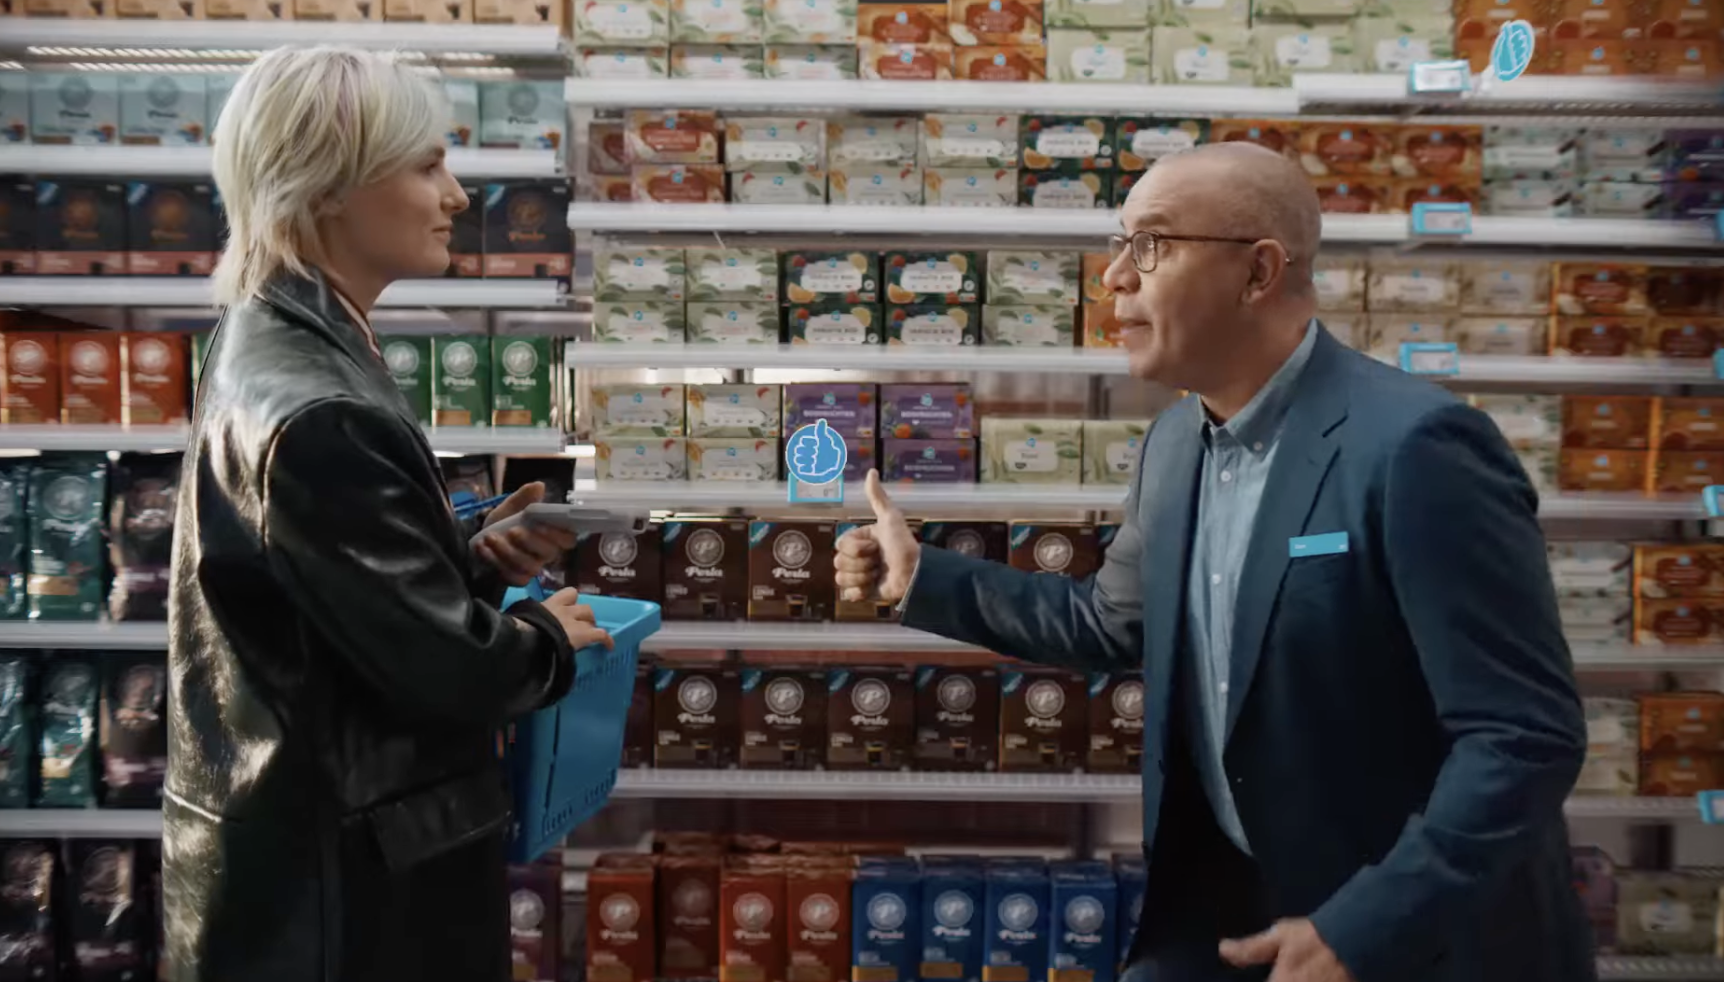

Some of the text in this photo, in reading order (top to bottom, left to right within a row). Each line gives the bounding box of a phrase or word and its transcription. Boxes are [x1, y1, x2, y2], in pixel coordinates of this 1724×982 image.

[598, 565, 636, 578] Perla
[685, 566, 723, 579] Perla
[772, 567, 811, 580] Perla
[677, 713, 716, 725] Perla
[764, 713, 802, 726] Perla
[850, 714, 889, 727] Perla
[937, 711, 974, 723] Perla
[1024, 716, 1063, 729] Perla
